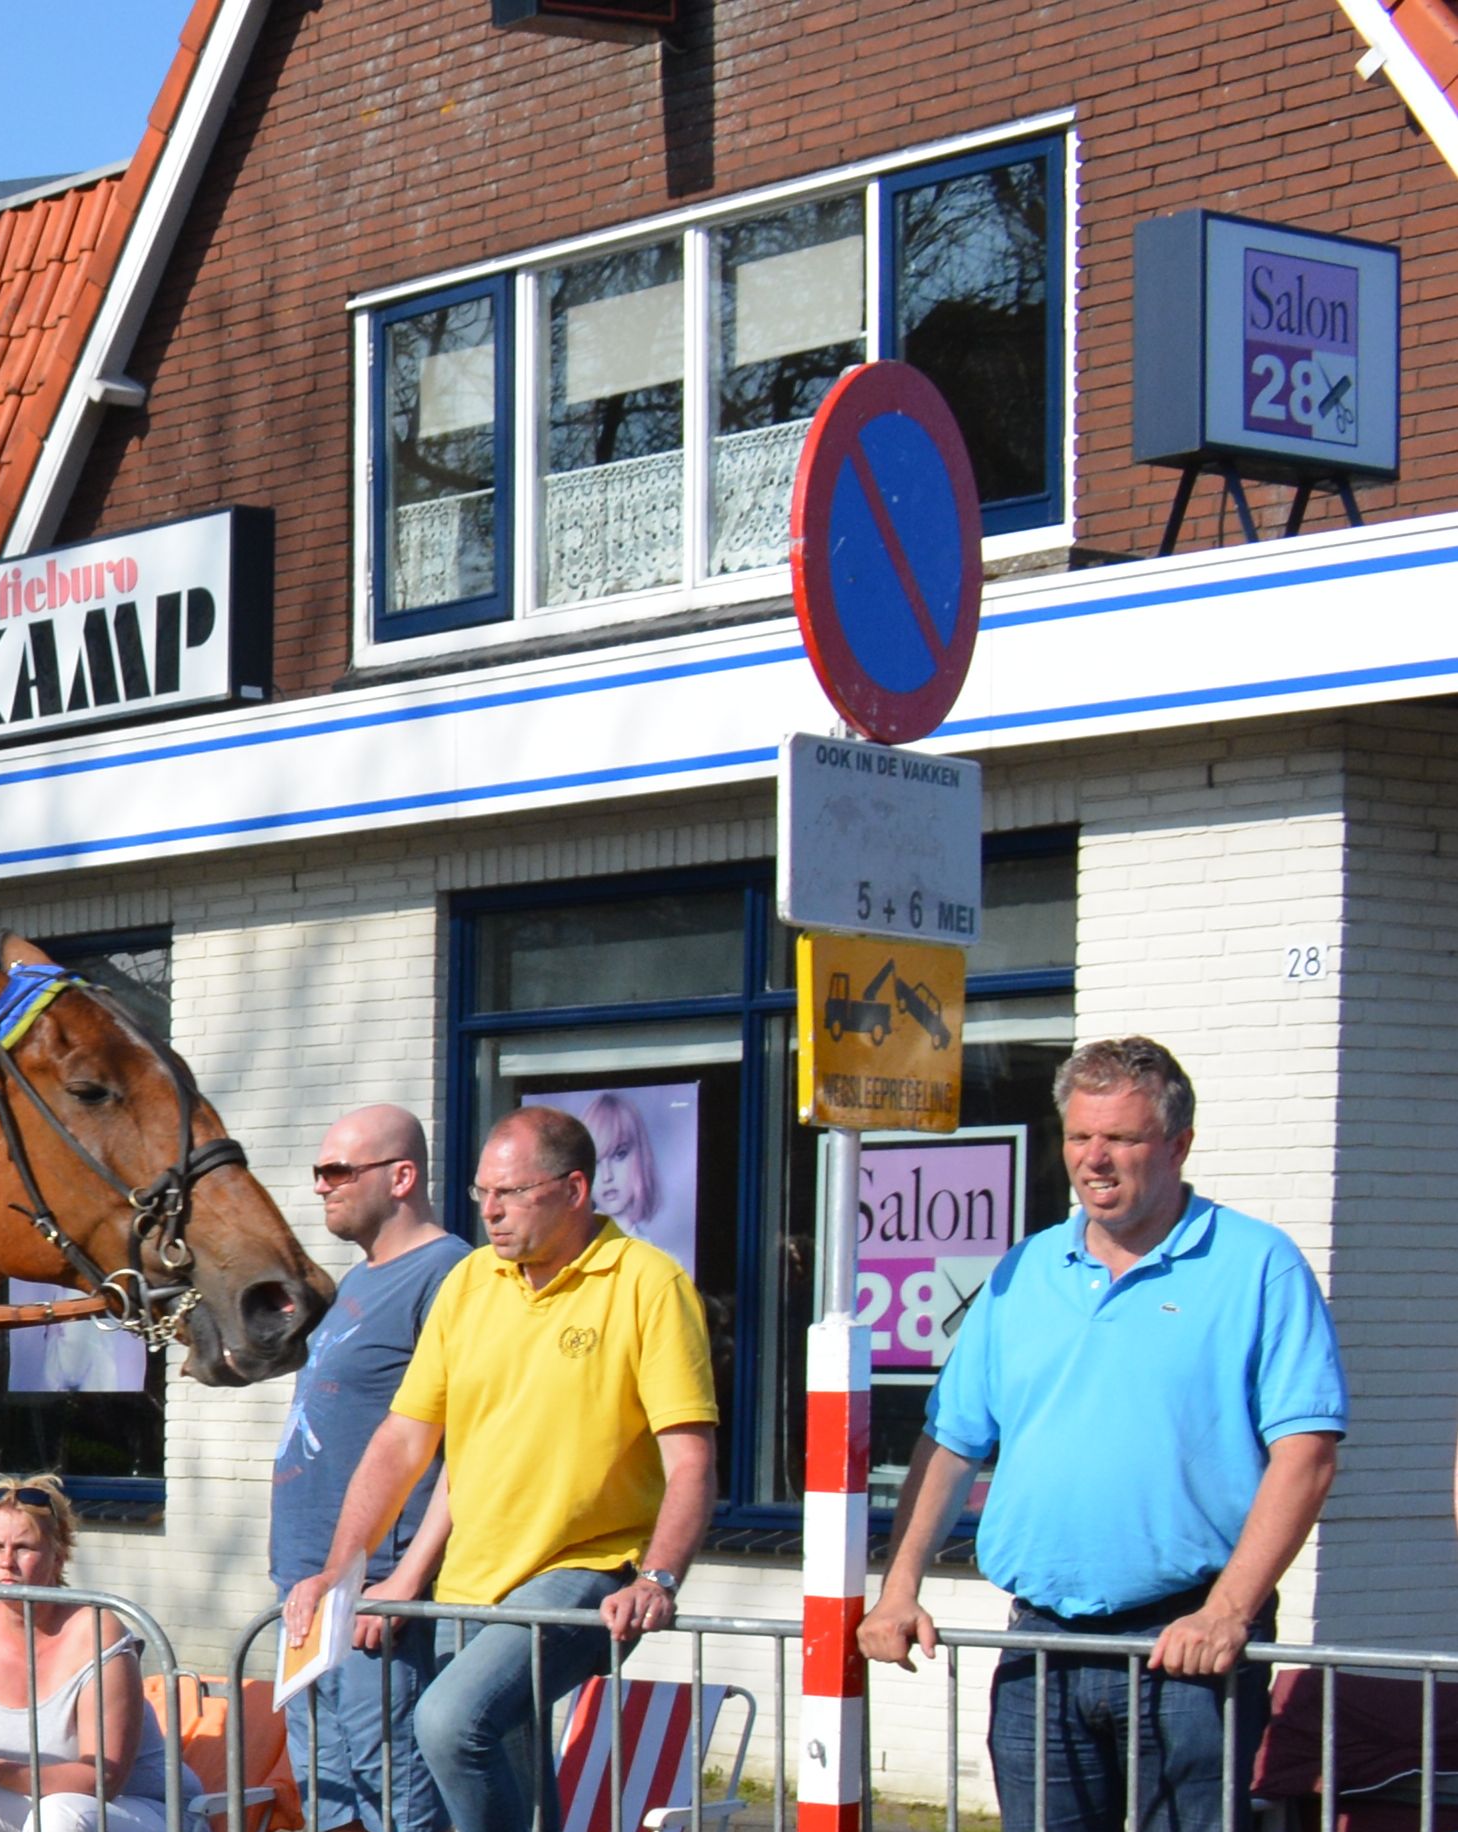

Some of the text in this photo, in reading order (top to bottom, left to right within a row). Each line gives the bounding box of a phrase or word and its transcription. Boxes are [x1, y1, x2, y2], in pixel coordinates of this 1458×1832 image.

[1250, 265, 1349, 344] Salon
[1250, 354, 1322, 426] 28
[816, 744, 960, 788] OOK IN DE VAKKEN
[857, 881, 871, 921] 5
[909, 890, 923, 929] 6
[937, 901, 975, 935] MEI
[1287, 946, 1321, 978] 28
[823, 1073, 953, 1112] WEGSLEEPREGELING
[857, 1270, 937, 1352] 28
